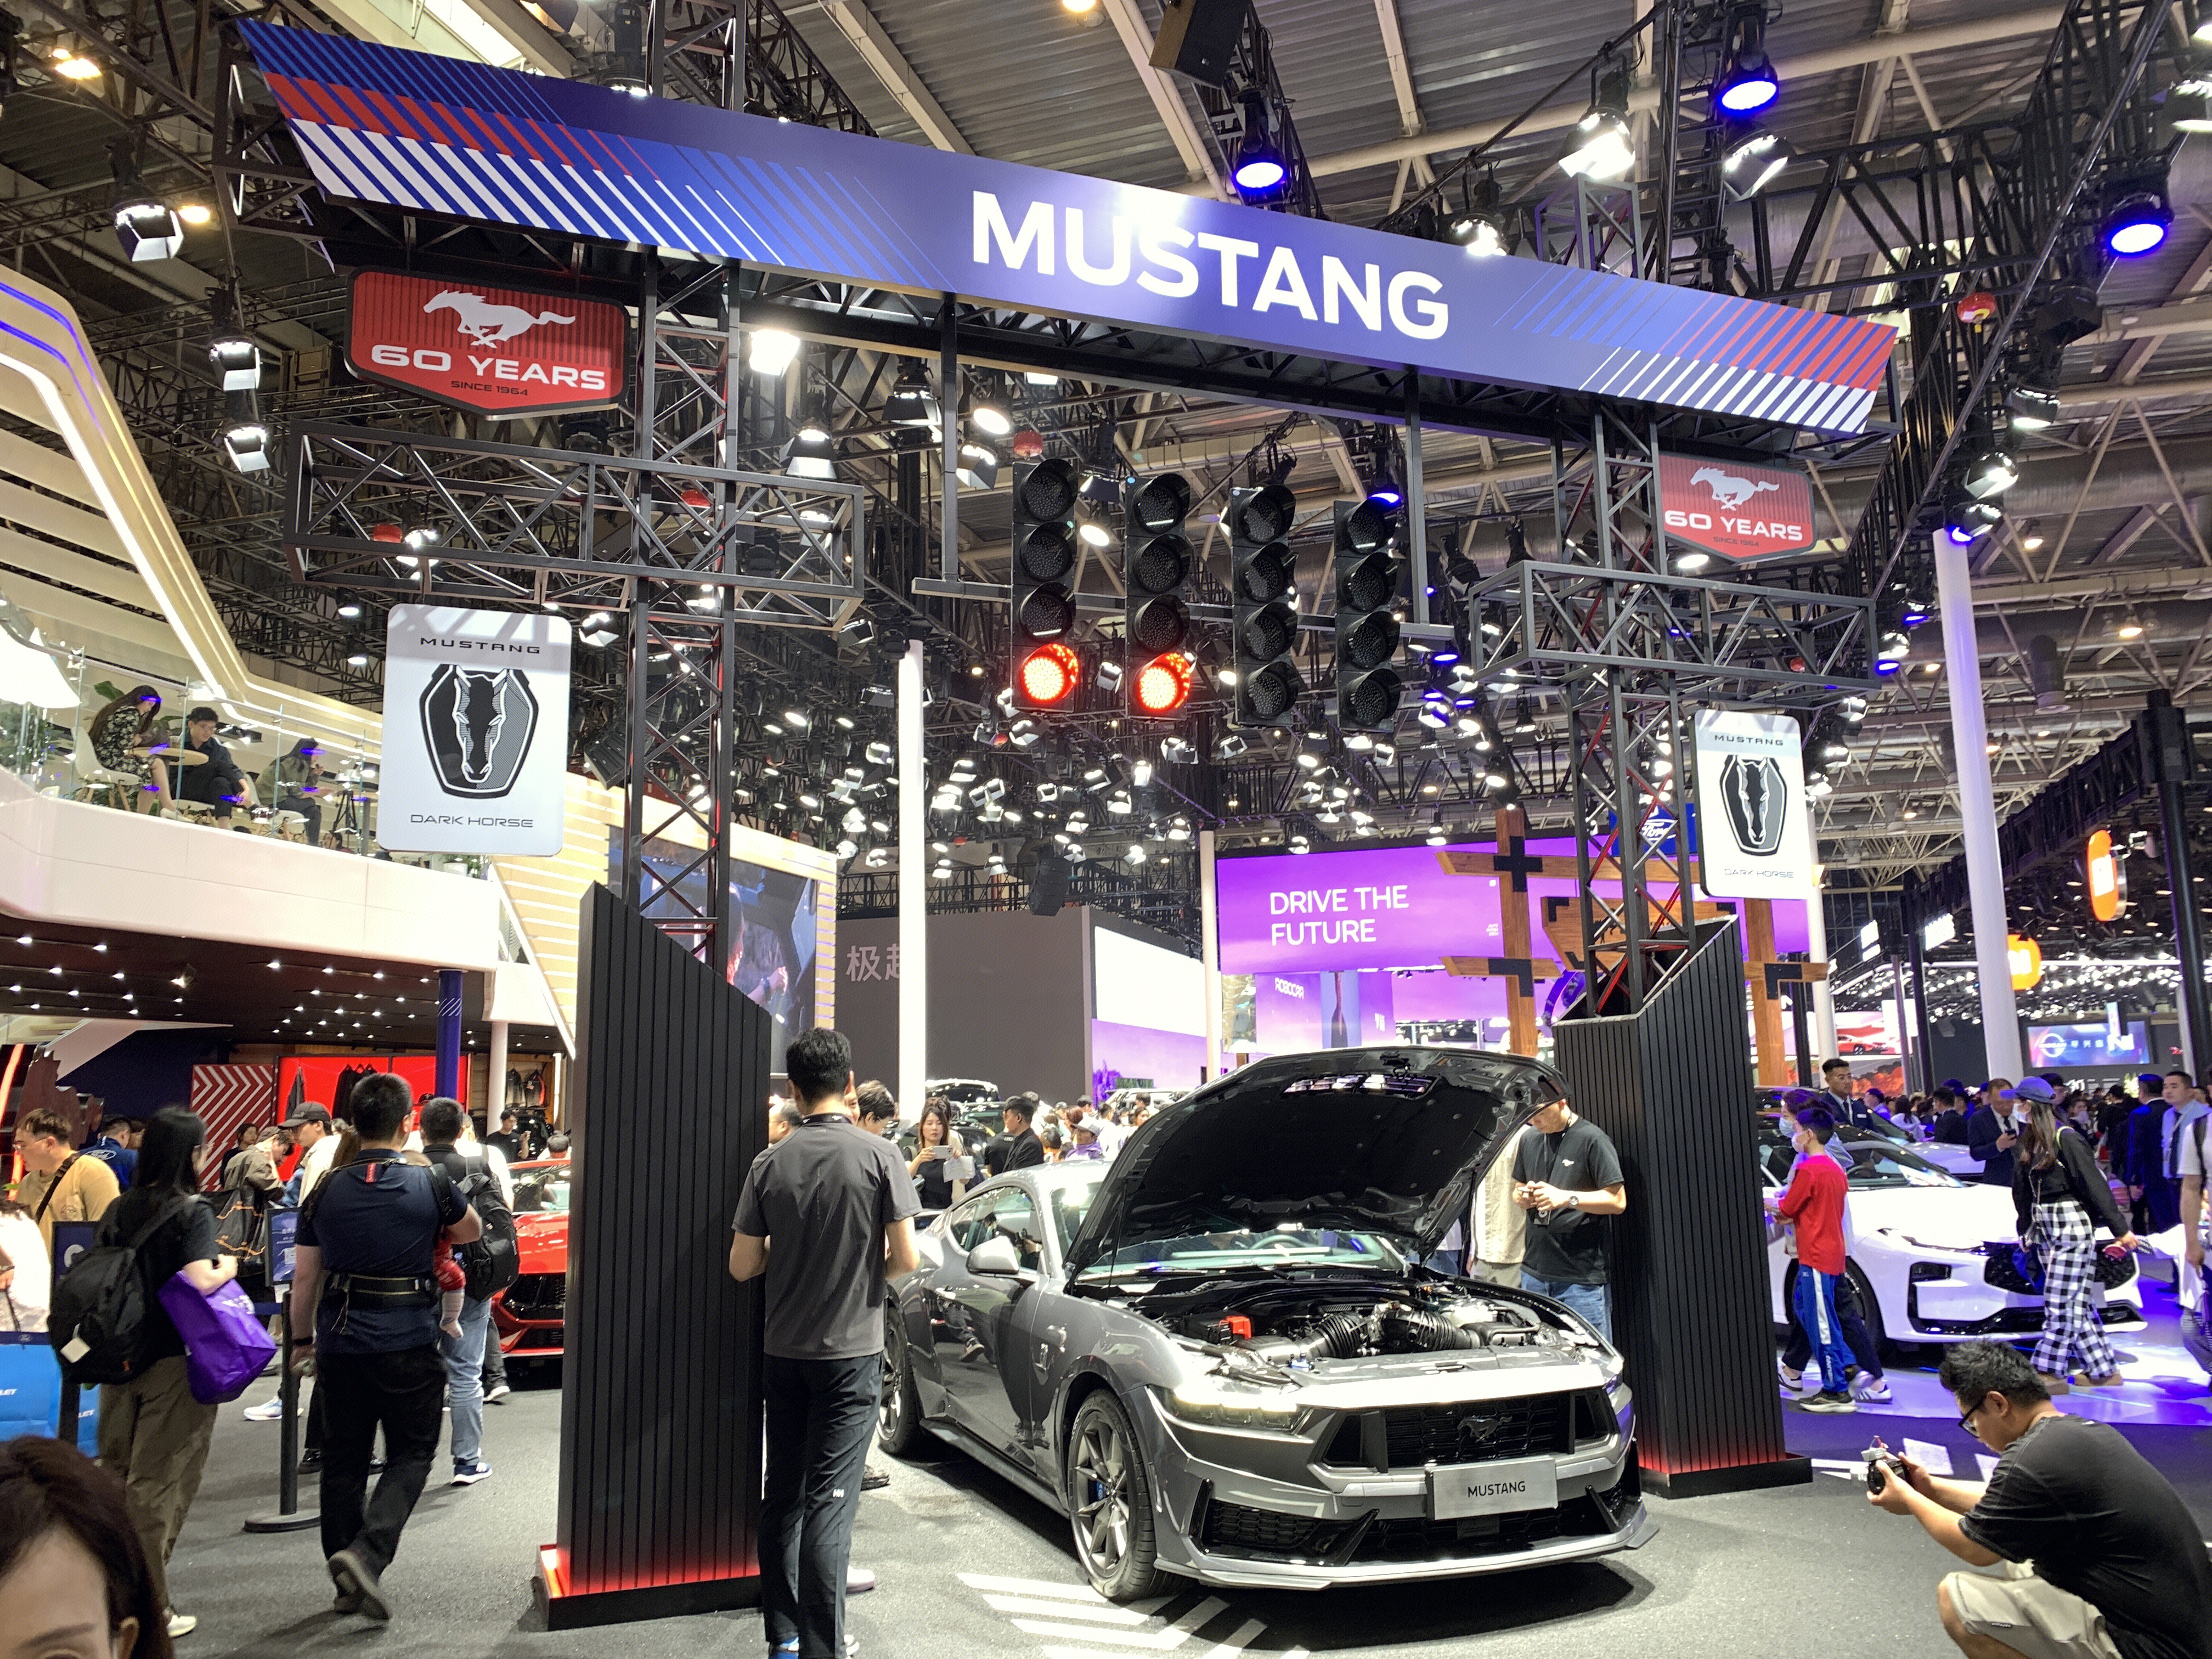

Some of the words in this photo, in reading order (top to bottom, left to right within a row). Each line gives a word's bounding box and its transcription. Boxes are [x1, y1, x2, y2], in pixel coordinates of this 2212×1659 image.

[973, 190, 1449, 340] MUSTANG
[371, 345, 452, 371] 60
[467, 355, 606, 390] YEARS
[450, 381, 492, 392] SINCE
[497, 386, 528, 396] 1964
[1664, 510, 1712, 530] 60
[1720, 516, 1803, 541] YEARS
[1713, 536, 1738, 545] SINCE
[420, 637, 540, 654] MUSTANG
[1714, 735, 1784, 746] MUSTANG
[410, 814, 464, 825] DARK
[468, 817, 534, 828] HORSE
[1270, 888, 1348, 915] DRIVE
[1353, 885, 1409, 911] THE
[1271, 918, 1376, 946] FUTURE
[1468, 1481, 1526, 1498] MUSTANG
